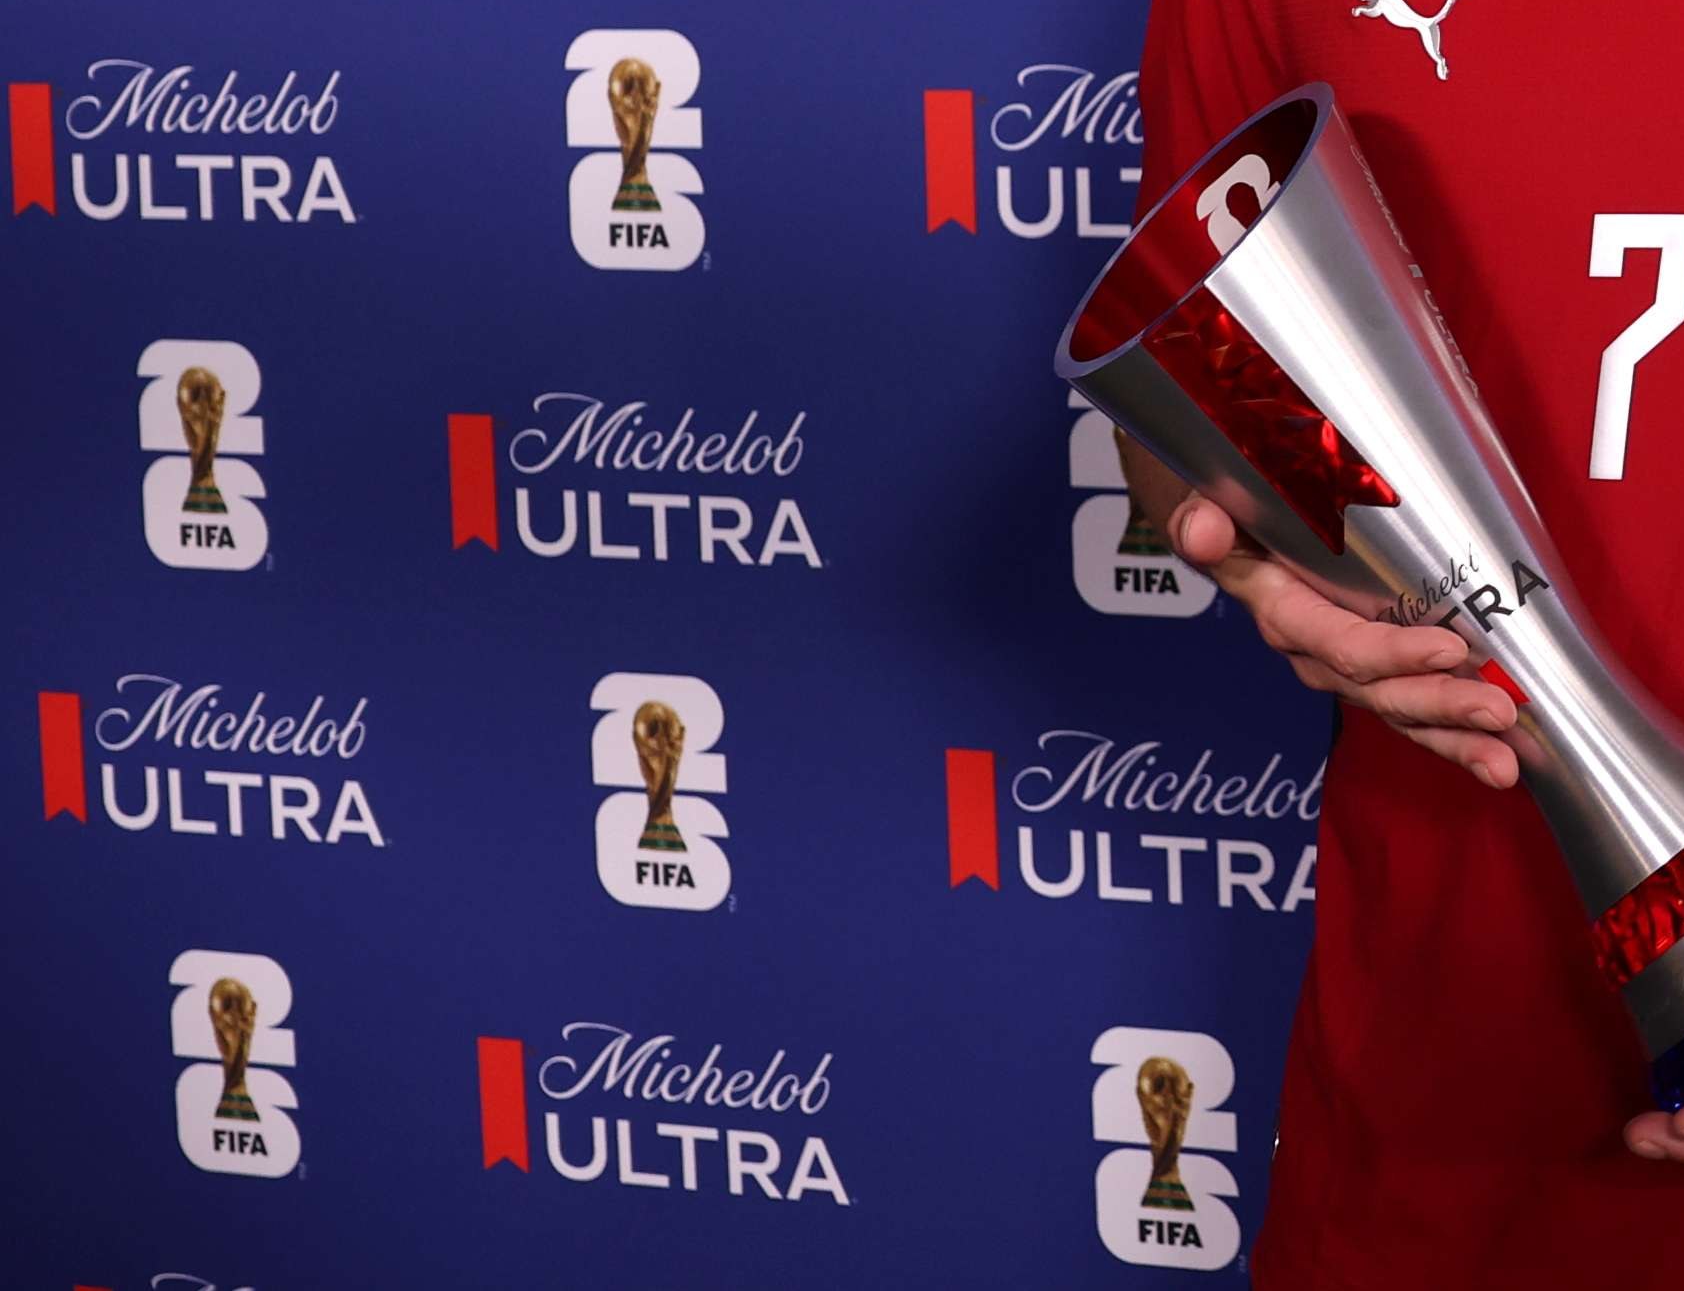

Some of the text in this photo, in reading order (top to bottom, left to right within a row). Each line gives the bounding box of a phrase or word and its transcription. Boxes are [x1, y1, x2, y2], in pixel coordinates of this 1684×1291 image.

[66, 59, 340, 139] Michelob
[72, 153, 356, 223] ULTRA
[609, 224, 669, 248] FIFA
[510, 392, 806, 476] Michelob
[181, 524, 236, 549] FIFA
[516, 488, 822, 568] ULTRA
[1114, 568, 1180, 594] FIFA
[1434, 559, 1550, 648] TRA
[95, 674, 368, 759] Michelob
[102, 764, 384, 846] ULTRA
[636, 862, 695, 888] FIFA
[539, 1022, 833, 1115] Michelob
[214, 1130, 268, 1156] FIFA
[545, 1112, 849, 1205] ULTRA
[1139, 1220, 1203, 1249] FIFA
